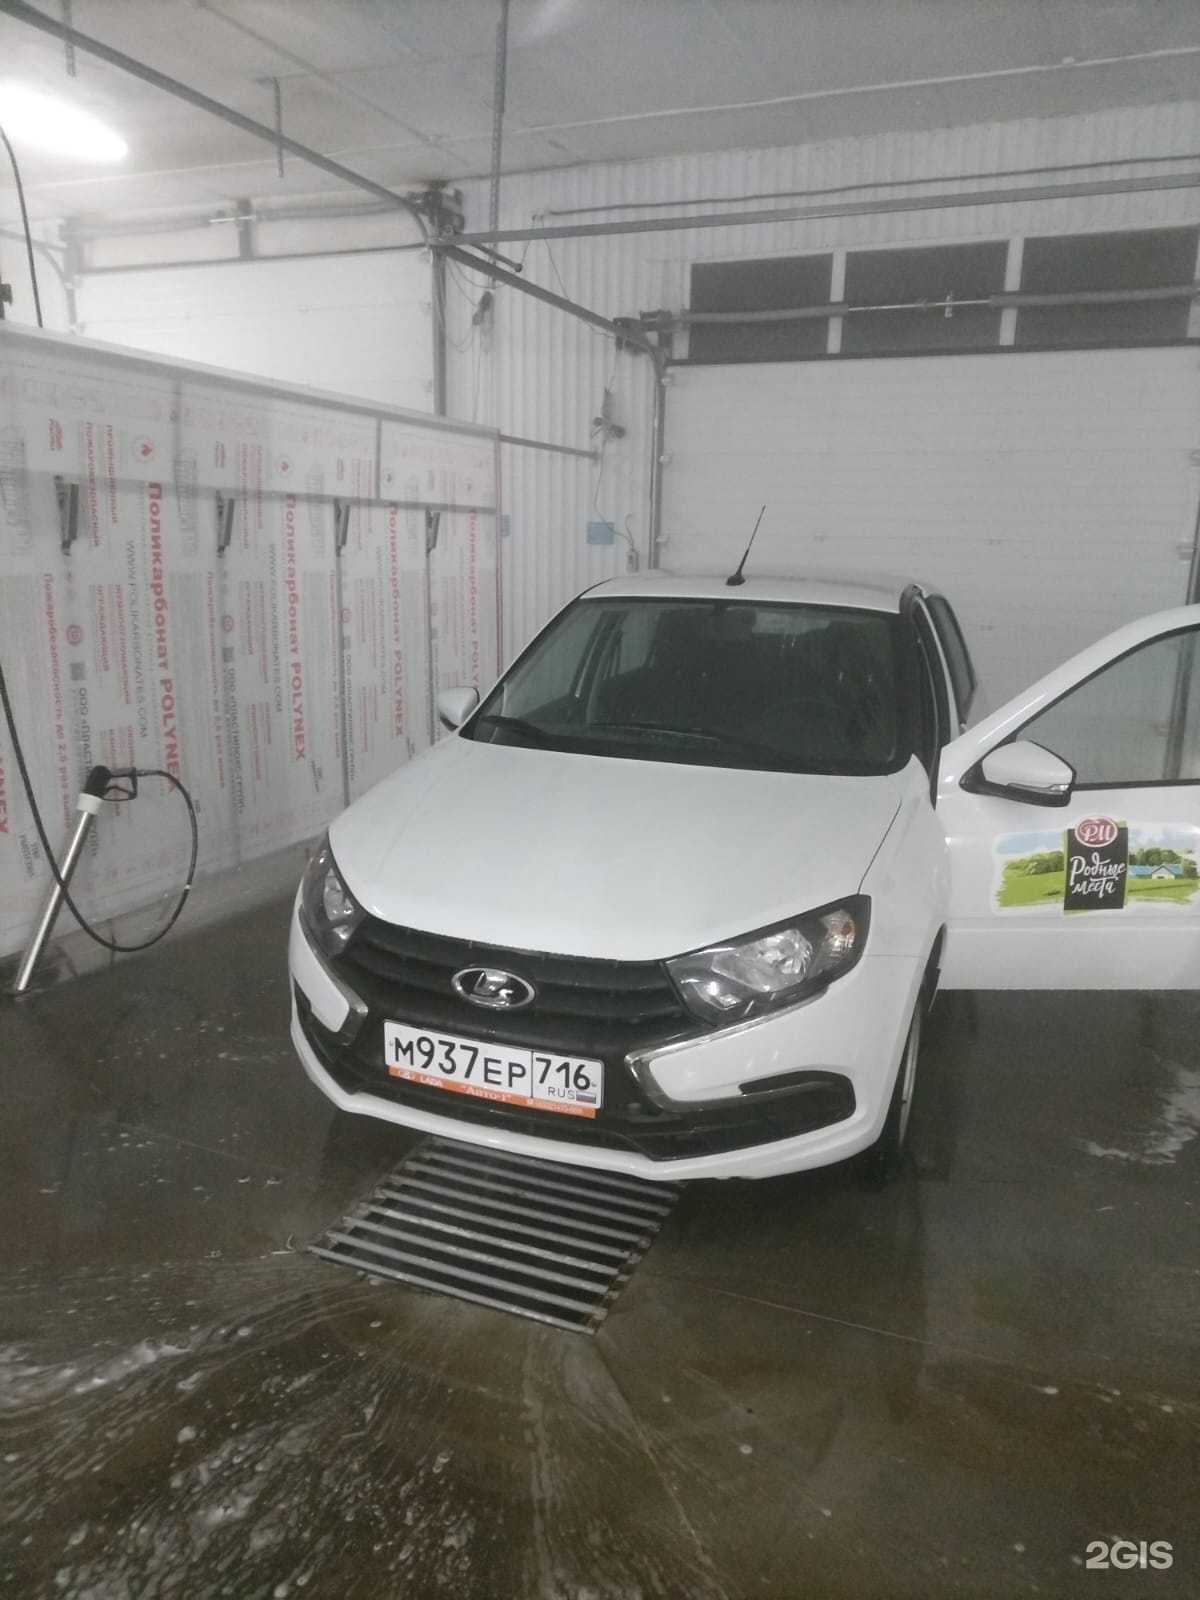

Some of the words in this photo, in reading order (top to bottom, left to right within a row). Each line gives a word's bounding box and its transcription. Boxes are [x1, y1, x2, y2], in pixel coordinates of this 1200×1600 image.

[149, 482, 168, 671] Поликарбонат
[284, 495, 299, 654] Поликарбонат
[388, 505, 401, 642] Поликарбонат
[471, 641, 480, 688] POLY
[78, 688, 89, 715] ООО
[291, 662, 306, 761] POLYNEX
[394, 649, 404, 738] POLYNEX
[1069, 852, 1126, 886] Родные
[1072, 879, 1116, 898] места
[394, 1036, 527, 1088] М937ЕР
[535, 1057, 591, 1091] 716
[548, 1087, 576, 1100] RUS
